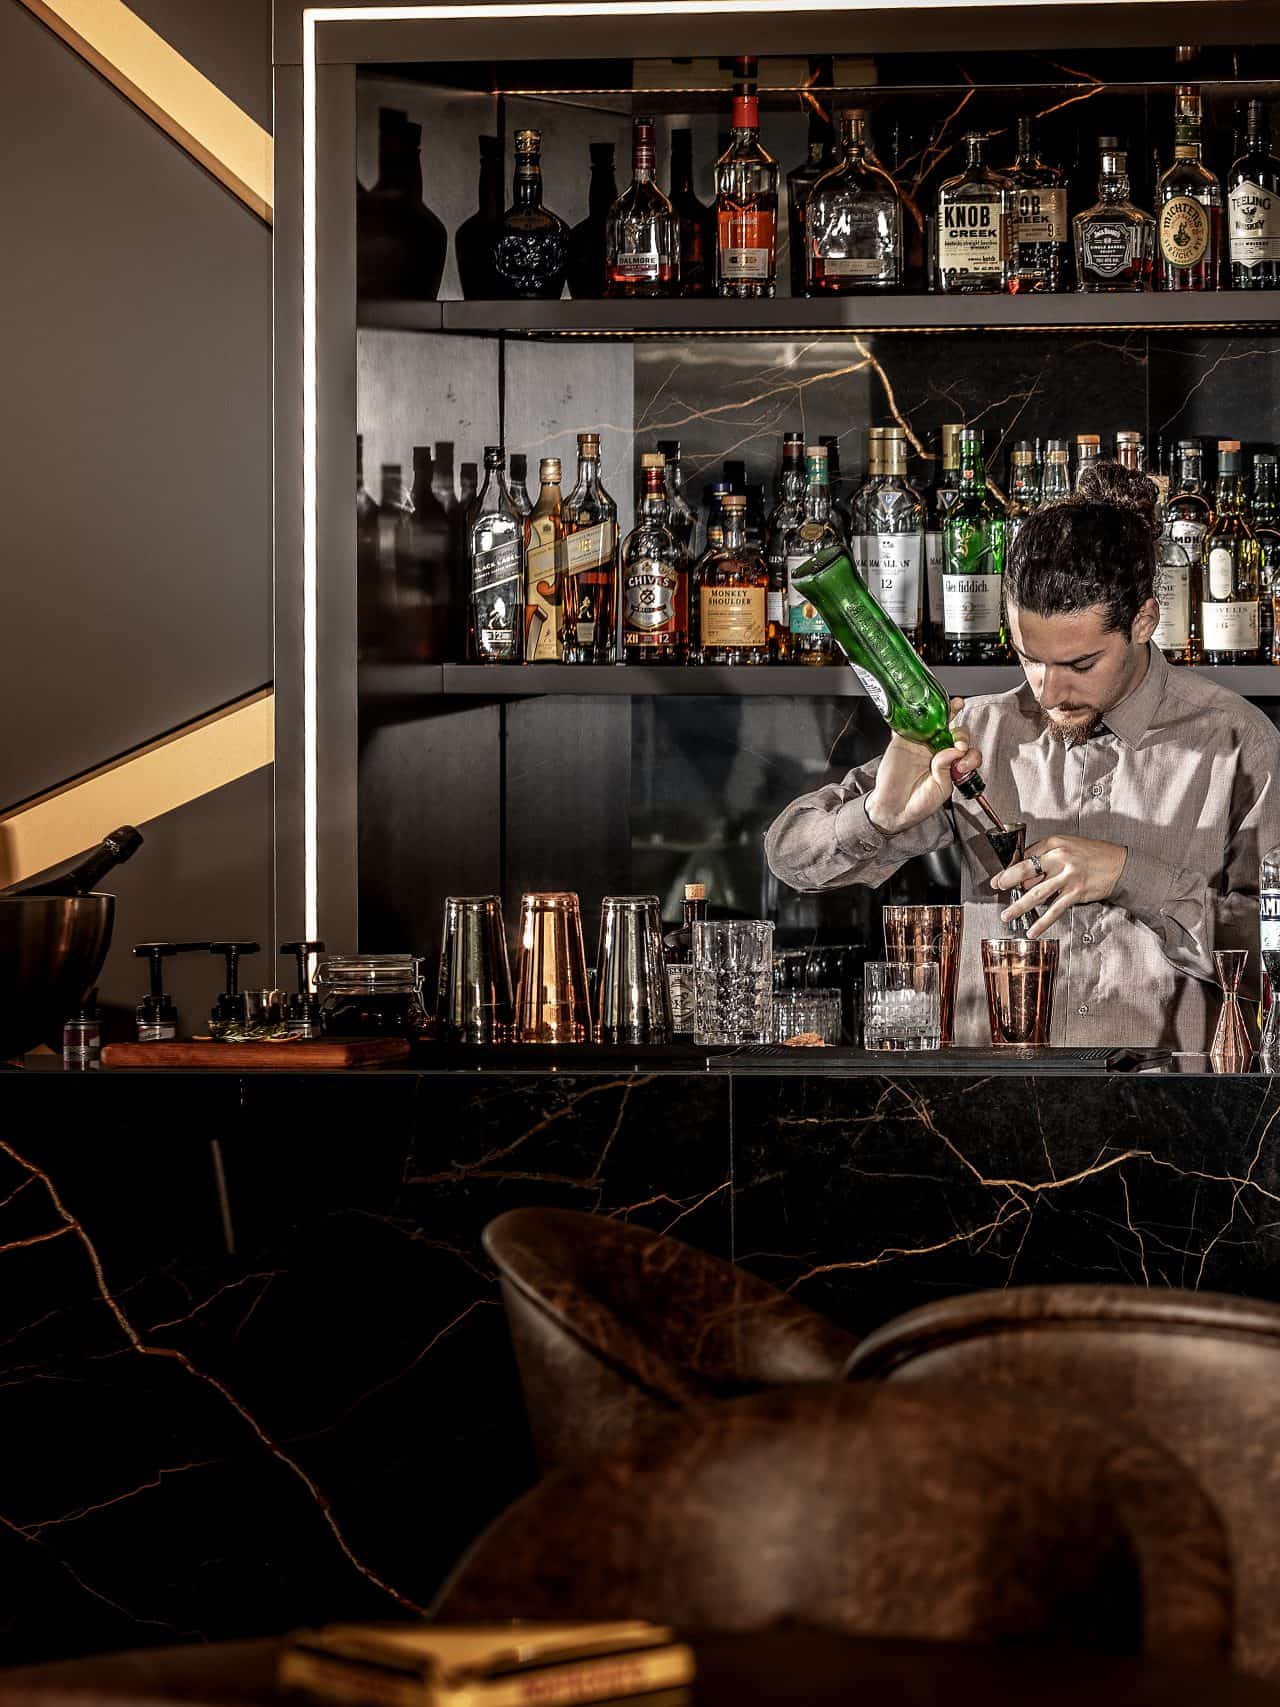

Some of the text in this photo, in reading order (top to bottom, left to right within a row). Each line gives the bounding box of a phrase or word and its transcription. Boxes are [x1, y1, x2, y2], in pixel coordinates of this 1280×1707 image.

[1231, 195, 1272, 211] TEELING
[944, 205, 990, 228] KNOB
[949, 229, 998, 238] CREEK
[1047, 223, 1054, 237] 9
[881, 579, 893, 589] 12
[626, 633, 639, 644] XII
[659, 633, 670, 643] 12
